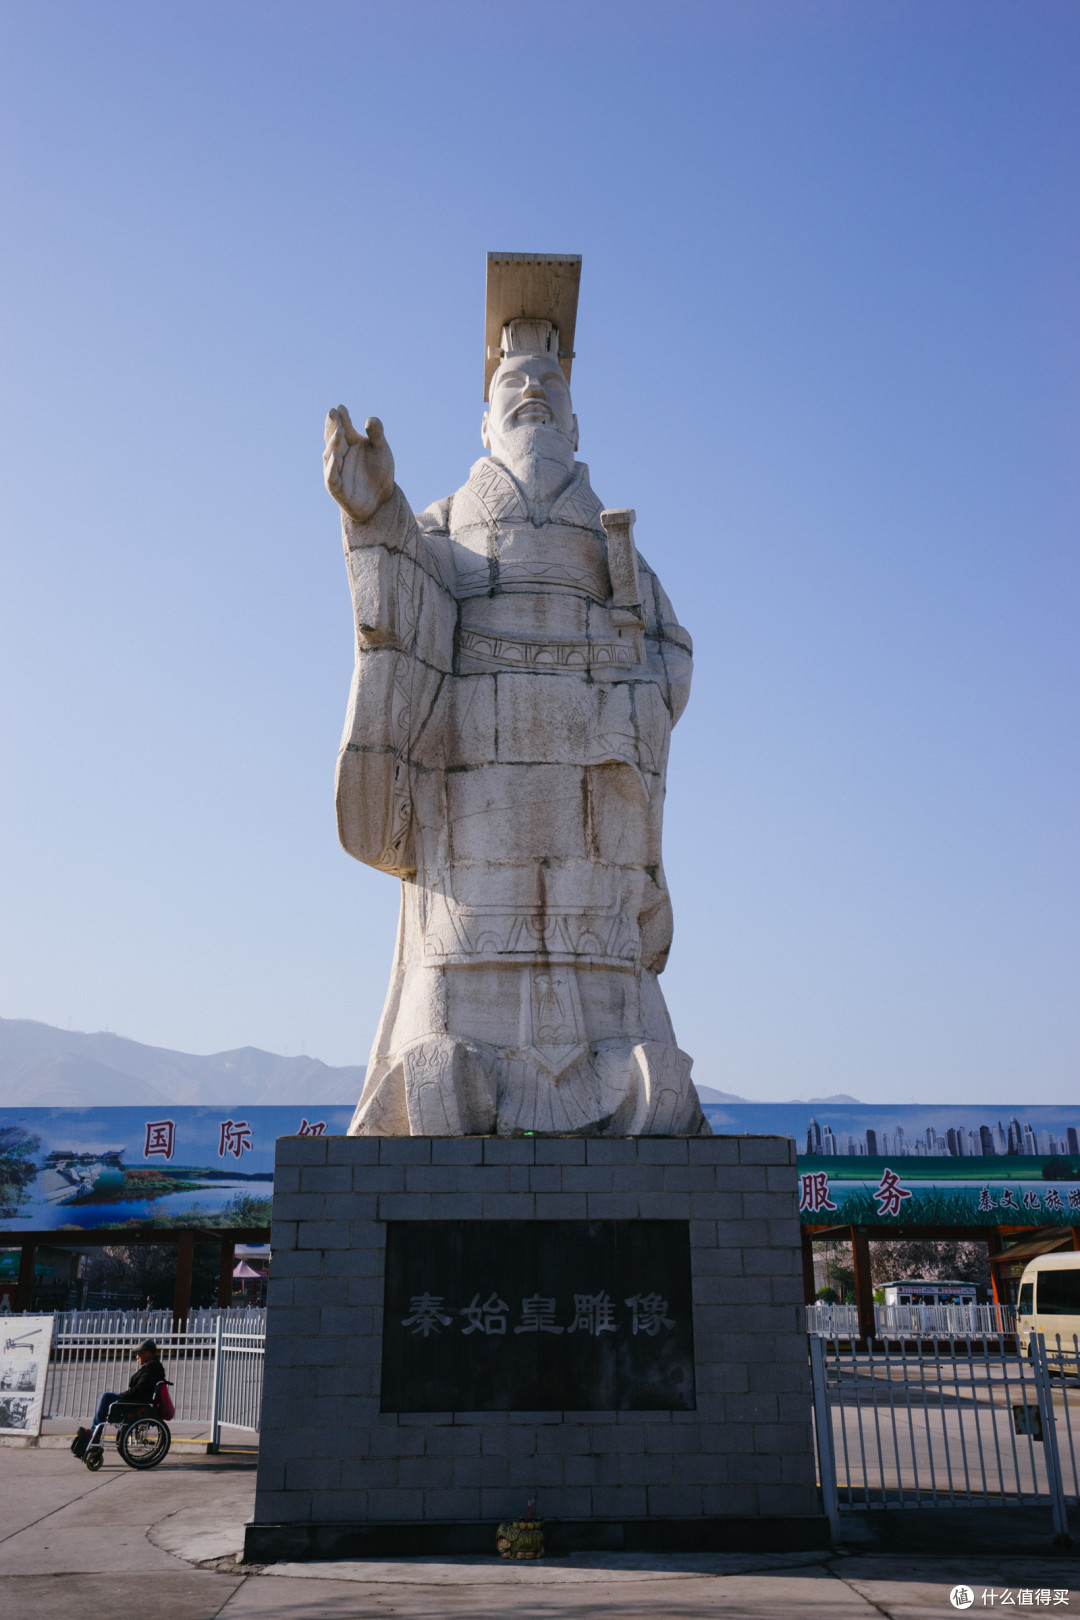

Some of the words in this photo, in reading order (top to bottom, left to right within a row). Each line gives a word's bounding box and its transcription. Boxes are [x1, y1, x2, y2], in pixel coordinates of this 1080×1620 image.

[799, 1168, 912, 1216] 服务
[401, 1291, 675, 1337] 秦始皇雕像
